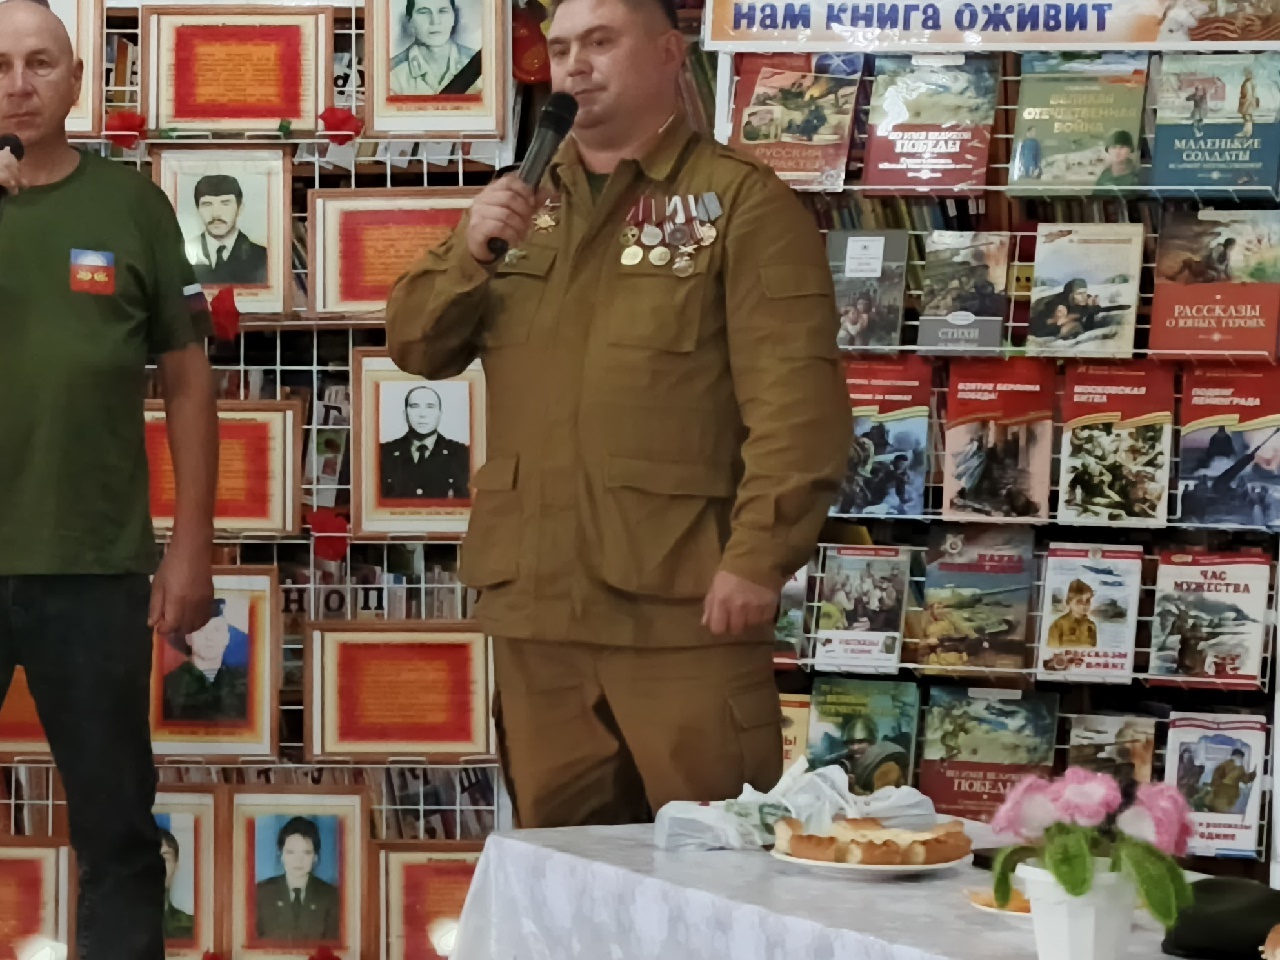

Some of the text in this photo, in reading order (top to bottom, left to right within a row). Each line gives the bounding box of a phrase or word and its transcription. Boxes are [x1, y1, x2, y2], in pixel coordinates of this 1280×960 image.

[733, 2, 1113, 32] нам книга оживит
[1172, 138, 1262, 150] МАЛЕНЬКИЕ
[1181, 150, 1251, 162] СОЛДАТЫ
[1174, 304, 1261, 317] РАССКАЗЫ
[1200, 569, 1227, 581] ЧАС
[1173, 580, 1251, 594] МУЖЕСТВА
[281, 587, 306, 613] Н
[1194, 832, 1237, 841] одине
